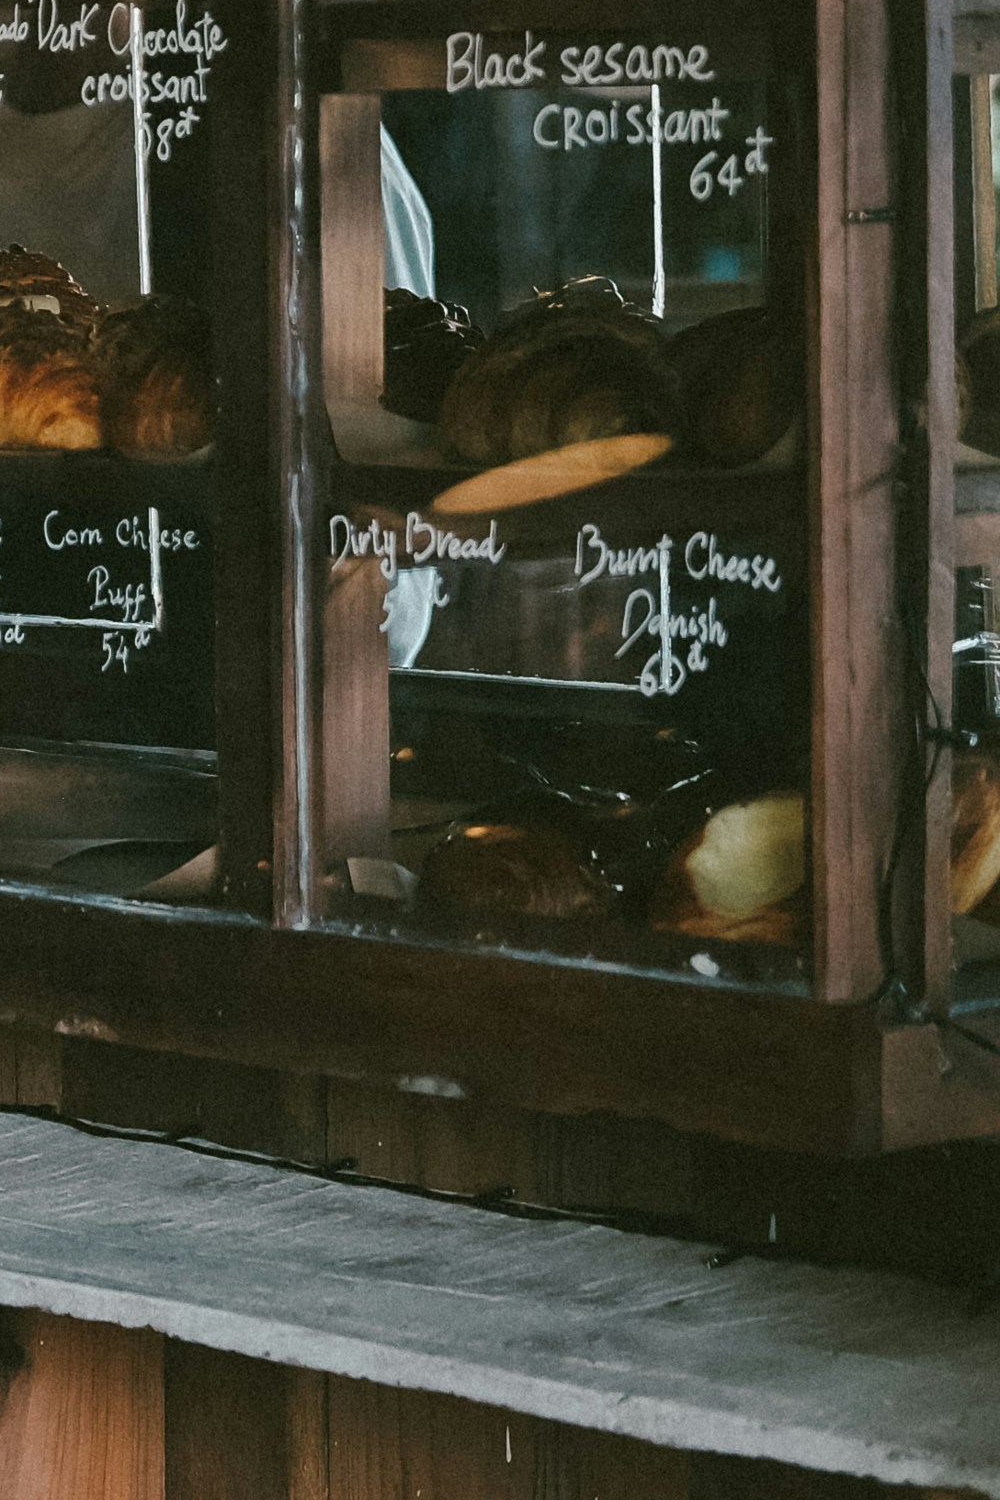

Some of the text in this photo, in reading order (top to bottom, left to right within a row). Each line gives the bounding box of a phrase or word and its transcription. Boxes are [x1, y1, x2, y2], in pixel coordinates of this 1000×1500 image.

[446, 30, 715, 93] Black sesame
[330, 511, 504, 578] Dirty Bread
[685, 531, 781, 592] Cheese
